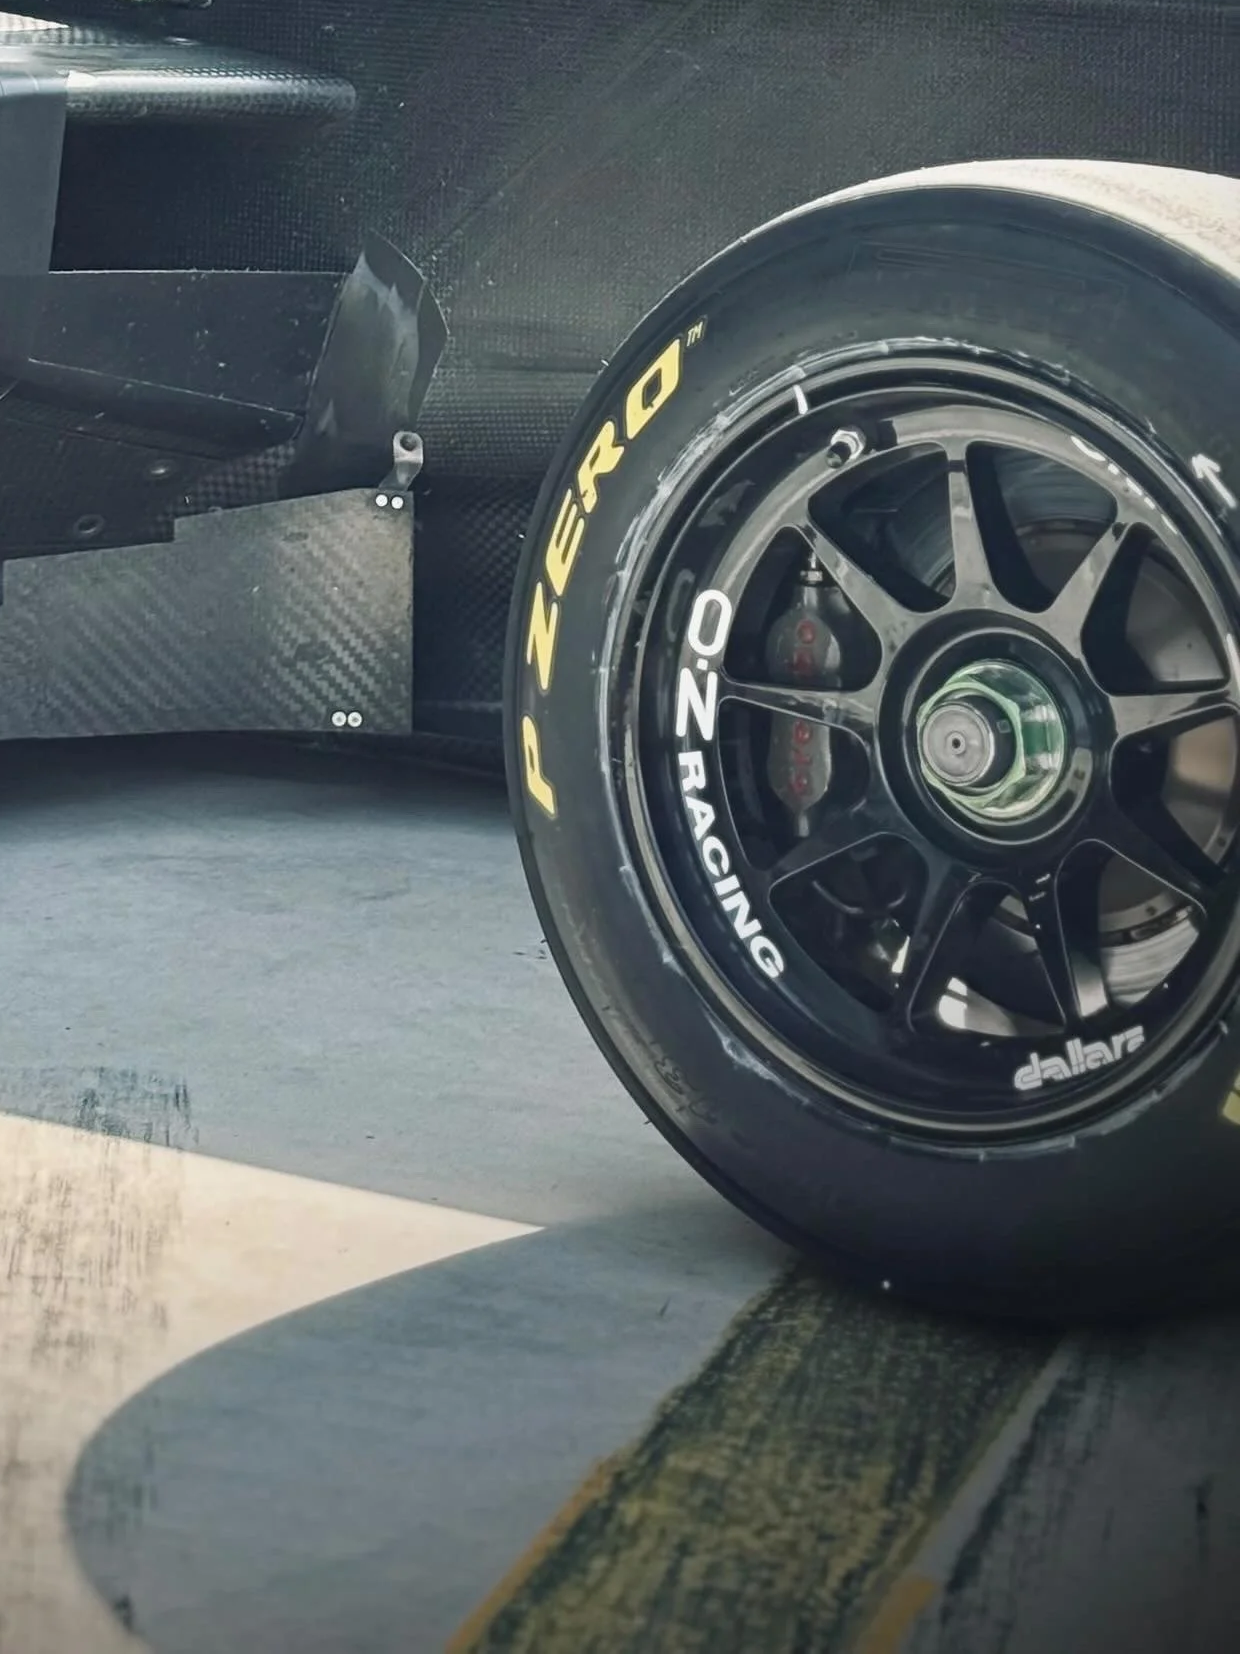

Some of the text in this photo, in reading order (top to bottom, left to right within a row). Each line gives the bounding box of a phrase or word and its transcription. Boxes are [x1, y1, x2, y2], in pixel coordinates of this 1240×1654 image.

[526, 338, 682, 692] ZERO
[522, 715, 556, 816] P
[677, 750, 785, 979] RACING
[1013, 1025, 1145, 1091] dallara
